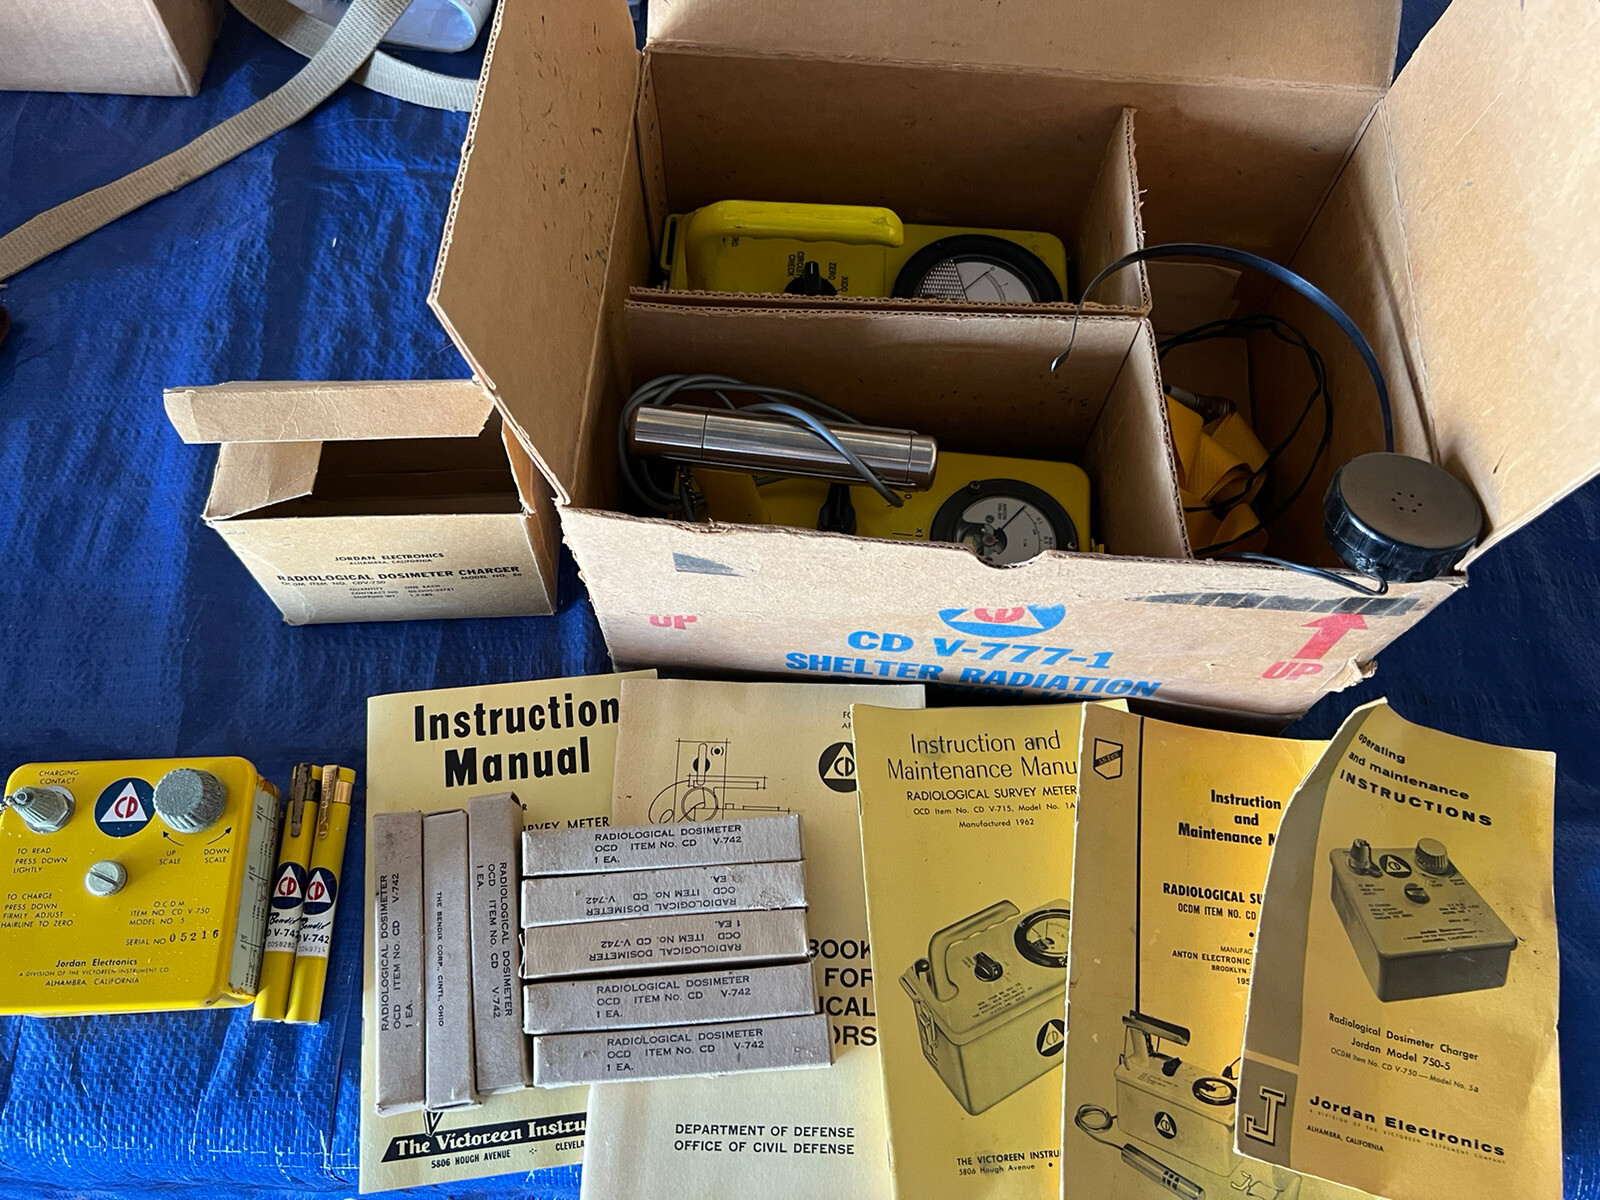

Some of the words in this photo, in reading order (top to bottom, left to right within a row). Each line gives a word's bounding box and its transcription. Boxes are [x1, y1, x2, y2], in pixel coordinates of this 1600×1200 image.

[788, 254, 796, 276] CHECK
[828, 262, 836, 280] ZERO
[381, 552, 444, 560] ELECTRONICS
[277, 574, 374, 582] RADIOLOGICAL
[378, 570, 454, 580] DOSIMETER
[458, 566, 519, 576] CHARGER
[847, 630, 914, 653] CD
[932, 637, 1115, 669] V-777-1
[785, 652, 944, 681] SHELTER
[958, 667, 1163, 698] RADIATION
[1262, 659, 1323, 683] UP
[414, 693, 620, 742] Instruction
[911, 733, 1021, 754] Instruction
[1024, 730, 1061, 751] and
[1358, 732, 1406, 764] operating
[445, 736, 590, 788] Manual
[834, 756, 855, 777] CD
[887, 757, 1012, 780] Maintenance
[39, 769, 80, 777] CHARGING
[40, 777, 76, 785] CONTACT
[1348, 751, 1365, 766] and
[1369, 762, 1470, 800] maintenance
[906, 789, 990, 801] RADIOLOGICAL
[994, 787, 1036, 798] SURVEY
[1042, 785, 1077, 796] METER
[1210, 789, 1282, 811] Instruction
[1339, 769, 1492, 826] INSTRUCTIONS
[114, 796, 138, 819] CD
[934, 807, 952, 815] Item
[989, 805, 1014, 813] V-715,
[1018, 804, 1042, 812] Model
[959, 819, 1011, 828] Manufactured
[1015, 818, 1034, 826] 1962
[1234, 813, 1259, 826] and
[594, 828, 677, 842] RADIOLOGICAL
[680, 824, 742, 836] DOSIMETER
[1178, 822, 1262, 846] Maintenance
[594, 844, 618, 853] OCD
[630, 840, 656, 851] ITEM
[659, 839, 677, 849] No.
[681, 838, 697, 848] CD
[712, 835, 742, 845] V-742
[158, 857, 181, 865] SCALE
[594, 856, 598, 864] 1
[603, 855, 620, 864] EA.
[278, 877, 296, 896] CD
[307, 881, 325, 900] CD
[392, 872, 400, 904] V-742
[1163, 882, 1245, 904] RADIOLOGICAL
[380, 874, 388, 939] DOSIMETER
[1178, 903, 1200, 914] OCDM
[1204, 906, 1223, 917] ITEM
[1227, 908, 1242, 919] NO.
[1246, 910, 1256, 920] CD
[270, 912, 301, 925] Bendix
[714, 920, 732, 928] EA.
[736, 920, 741, 928] 1
[392, 920, 400, 936] CD
[717, 931, 741, 940] OCD
[125, 938, 149, 946] SERIAL
[600, 938, 632, 948] V-742
[636, 937, 652, 946] CD
[656, 935, 674, 945] No.
[678, 933, 705, 942] ITEM
[393, 940, 401, 960] No.
[588, 949, 653, 962] DOSIMETER
[658, 943, 742, 956] RADIOLOGICAL
[1172, 950, 1199, 960] ANTON
[55, 959, 86, 968] Jordan
[92, 958, 138, 967] Electronics
[1211, 965, 1247, 974] BROOKLYN
[380, 943, 390, 1032] RADIOLOGICAL
[1328, 1013, 1381, 1037] Radiological
[1386, 1030, 1435, 1050] Dosimeter
[1439, 1044, 1478, 1062] Charger
[1351, 1037, 1381, 1054] Jordan
[1386, 1048, 1417, 1064] Model
[1422, 1055, 1451, 1071] 750-5
[675, 1124, 765, 1135] DEPARTMENT
[770, 1126, 788, 1136] OF
[794, 1126, 855, 1137] DEFENSE
[1309, 1095, 1376, 1124] Jordan
[1384, 1115, 1505, 1157] Electronics
[396, 1140, 431, 1156] The
[435, 1129, 522, 1151] Victoreen
[674, 1140, 722, 1151] OFFICE
[729, 1142, 746, 1152] OF
[753, 1142, 787, 1152] CIVIL
[793, 1143, 855, 1154] DEFENSE
[1306, 1124, 1344, 1142] ALHAMBRA,
[1345, 1135, 1384, 1152] CALIFORNIA
[431, 1159, 450, 1168] 5806
[455, 1155, 480, 1165] HOUGH
[484, 1150, 510, 1160] AVENUE
[956, 1156, 972, 1166] THE
[977, 1152, 1025, 1164] VICTOREEN
[958, 1168, 976, 1176] 5806
[980, 1165, 1004, 1175] Hough
[1008, 1163, 1035, 1171] Avenue
